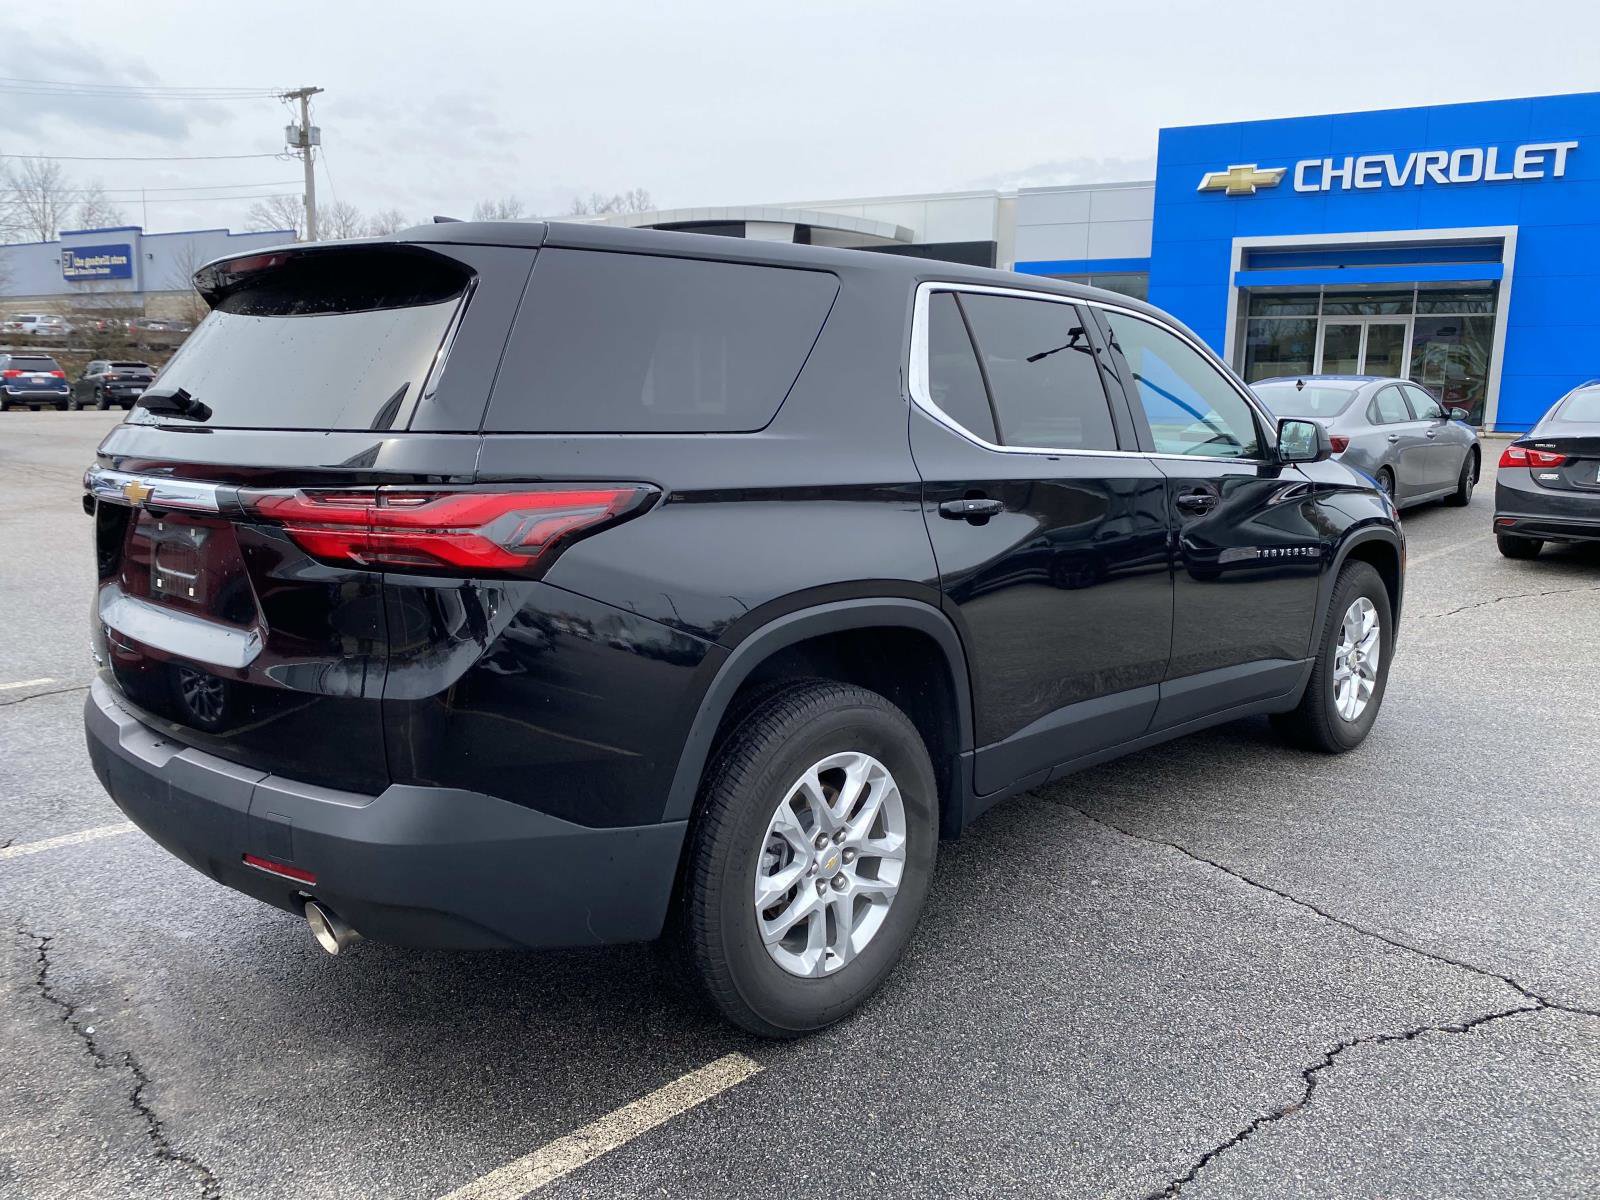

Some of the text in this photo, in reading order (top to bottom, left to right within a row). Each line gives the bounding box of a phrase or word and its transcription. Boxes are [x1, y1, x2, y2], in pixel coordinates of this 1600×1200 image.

[1294, 141, 1579, 193] CHEVROLET
[74, 255, 127, 268] the goodwill store
[1256, 547, 1314, 558] TRAVERSE
